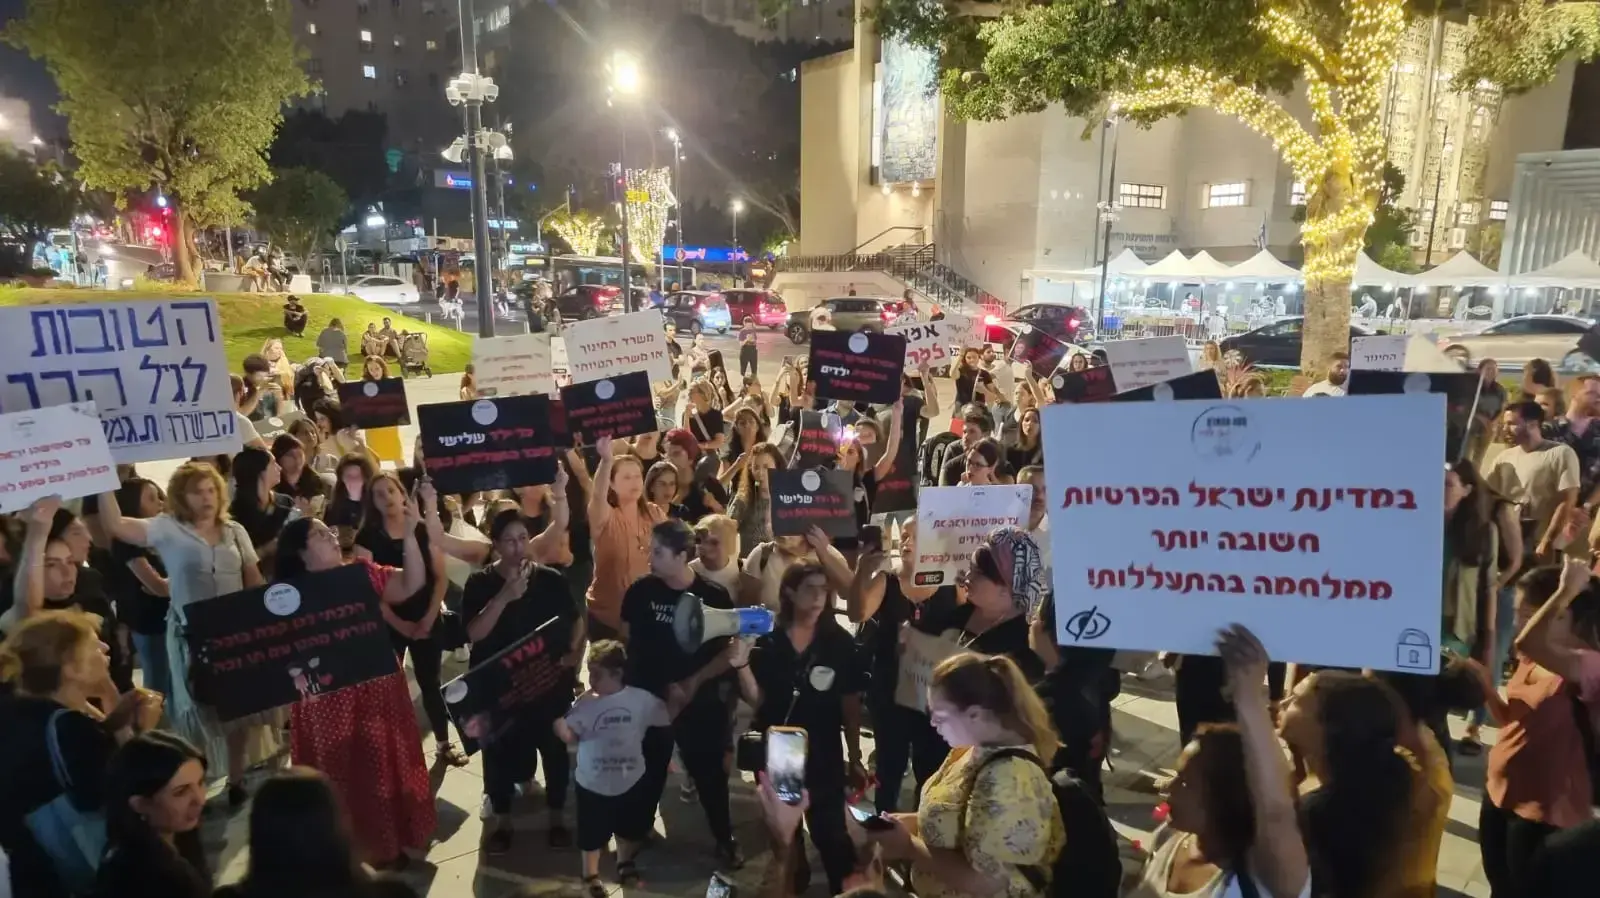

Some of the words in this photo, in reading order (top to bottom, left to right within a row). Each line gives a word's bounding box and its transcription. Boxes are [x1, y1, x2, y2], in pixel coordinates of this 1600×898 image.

[30, 302, 215, 357] הטובות
[622, 333, 654, 345] משרד
[580, 340, 617, 354] החינוך
[651, 350, 664, 359] או
[1364, 353, 1396, 362] החינוך
[616, 353, 648, 365] משרד
[140, 355, 207, 406] לגיל
[439, 432, 485, 446] שלישי
[780, 493, 813, 504] שלישי
[1061, 487, 1180, 509] הפרטיות
[1188, 480, 1286, 509] ישראל
[1290, 487, 1417, 511] במדינת
[959, 533, 986, 545] ילדים
[1151, 529, 1208, 552] יותר
[1218, 531, 1320, 553] חשובה
[1087, 561, 1246, 594] בהתעללות!
[1254, 570, 1392, 601] ממלחמה
